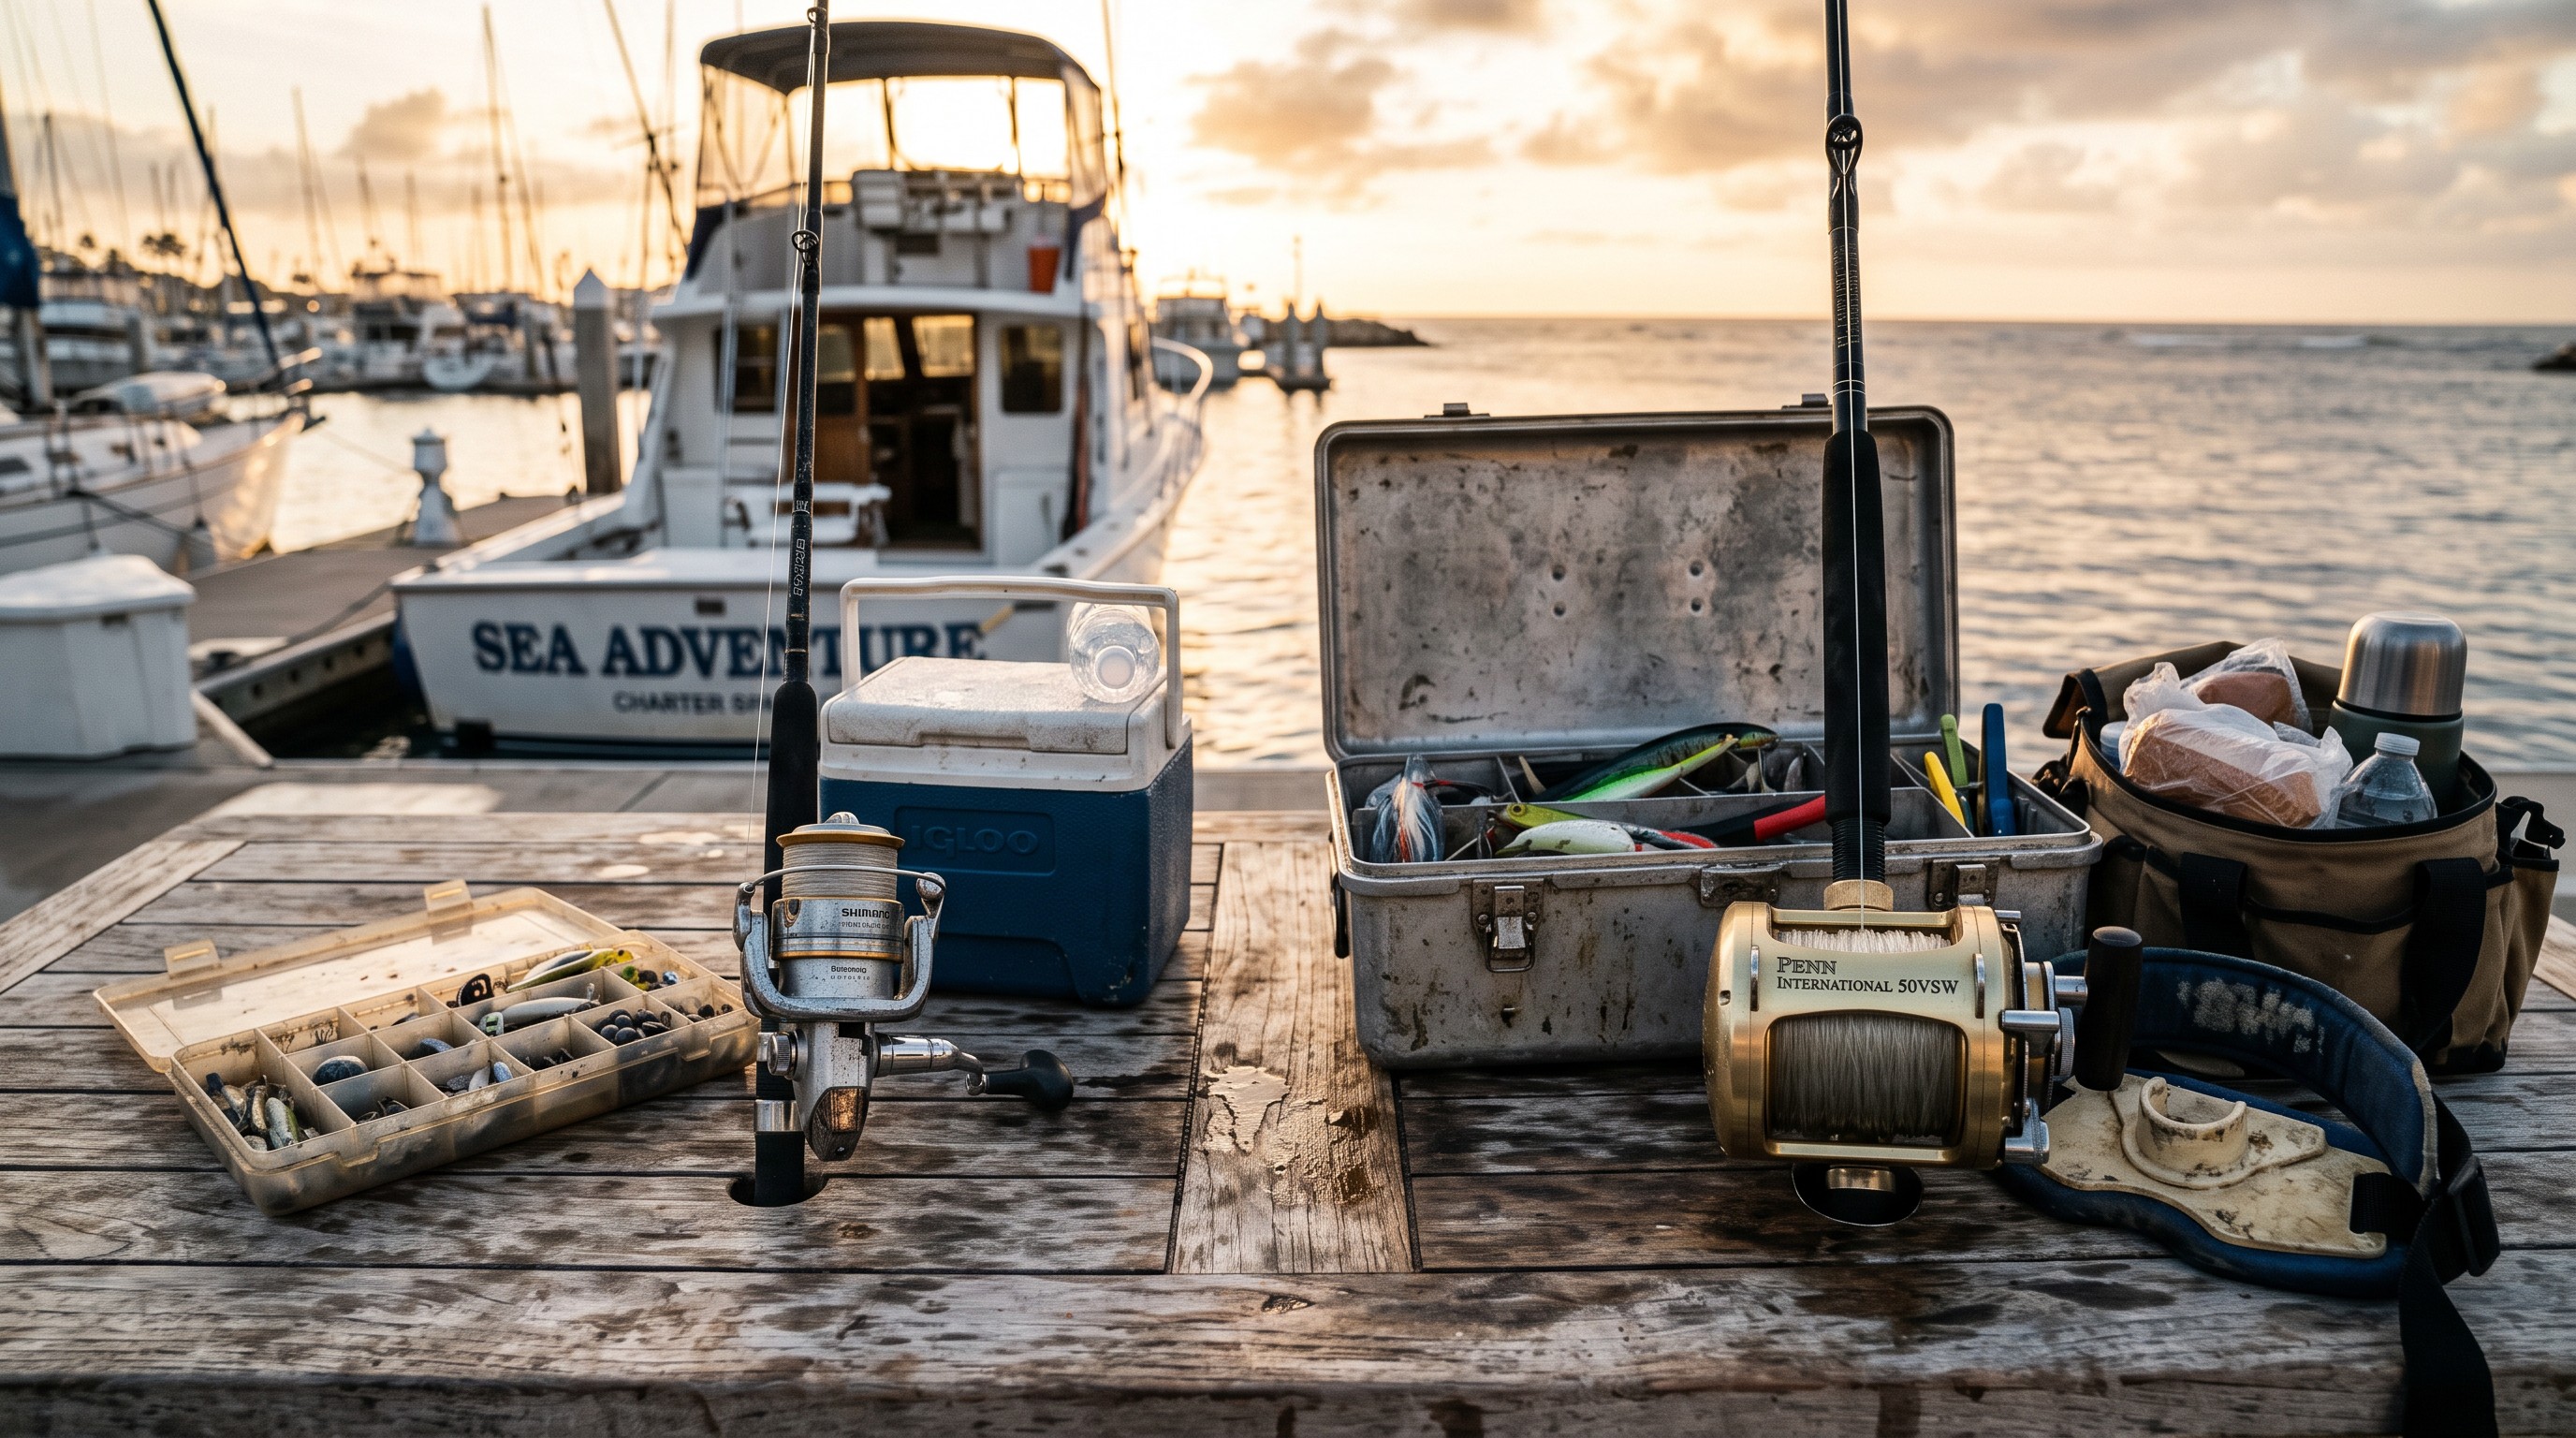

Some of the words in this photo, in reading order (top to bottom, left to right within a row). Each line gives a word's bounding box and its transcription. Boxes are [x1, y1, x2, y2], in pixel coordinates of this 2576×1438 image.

[473, 622, 587, 678] SEA
[613, 691, 724, 714] CHARTER
[911, 824, 1038, 858] IGLOO
[1777, 957, 1837, 976] PENN
[1777, 976, 1893, 992] INTERNATIONAL
[1898, 979, 1959, 994] 50VSW
